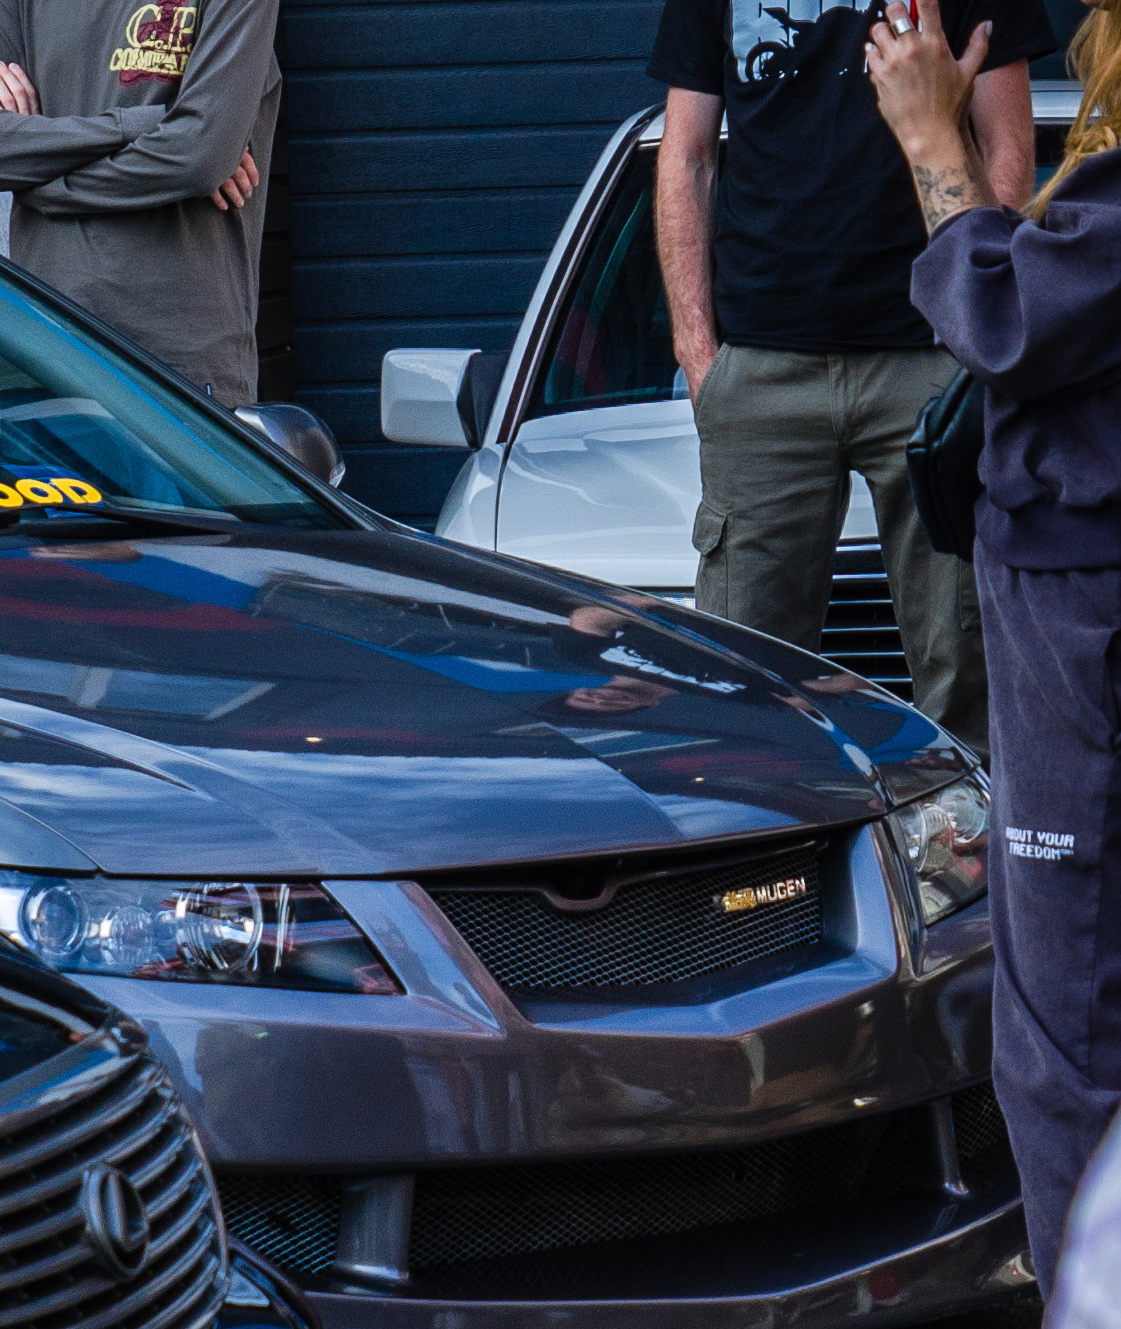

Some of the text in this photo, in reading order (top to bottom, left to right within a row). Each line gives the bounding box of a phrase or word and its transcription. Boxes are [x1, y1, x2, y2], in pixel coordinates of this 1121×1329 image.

[109, 47, 190, 76] COMPA
[1036, 831, 1075, 848] YOUR
[755, 876, 807, 903] MUGEN
